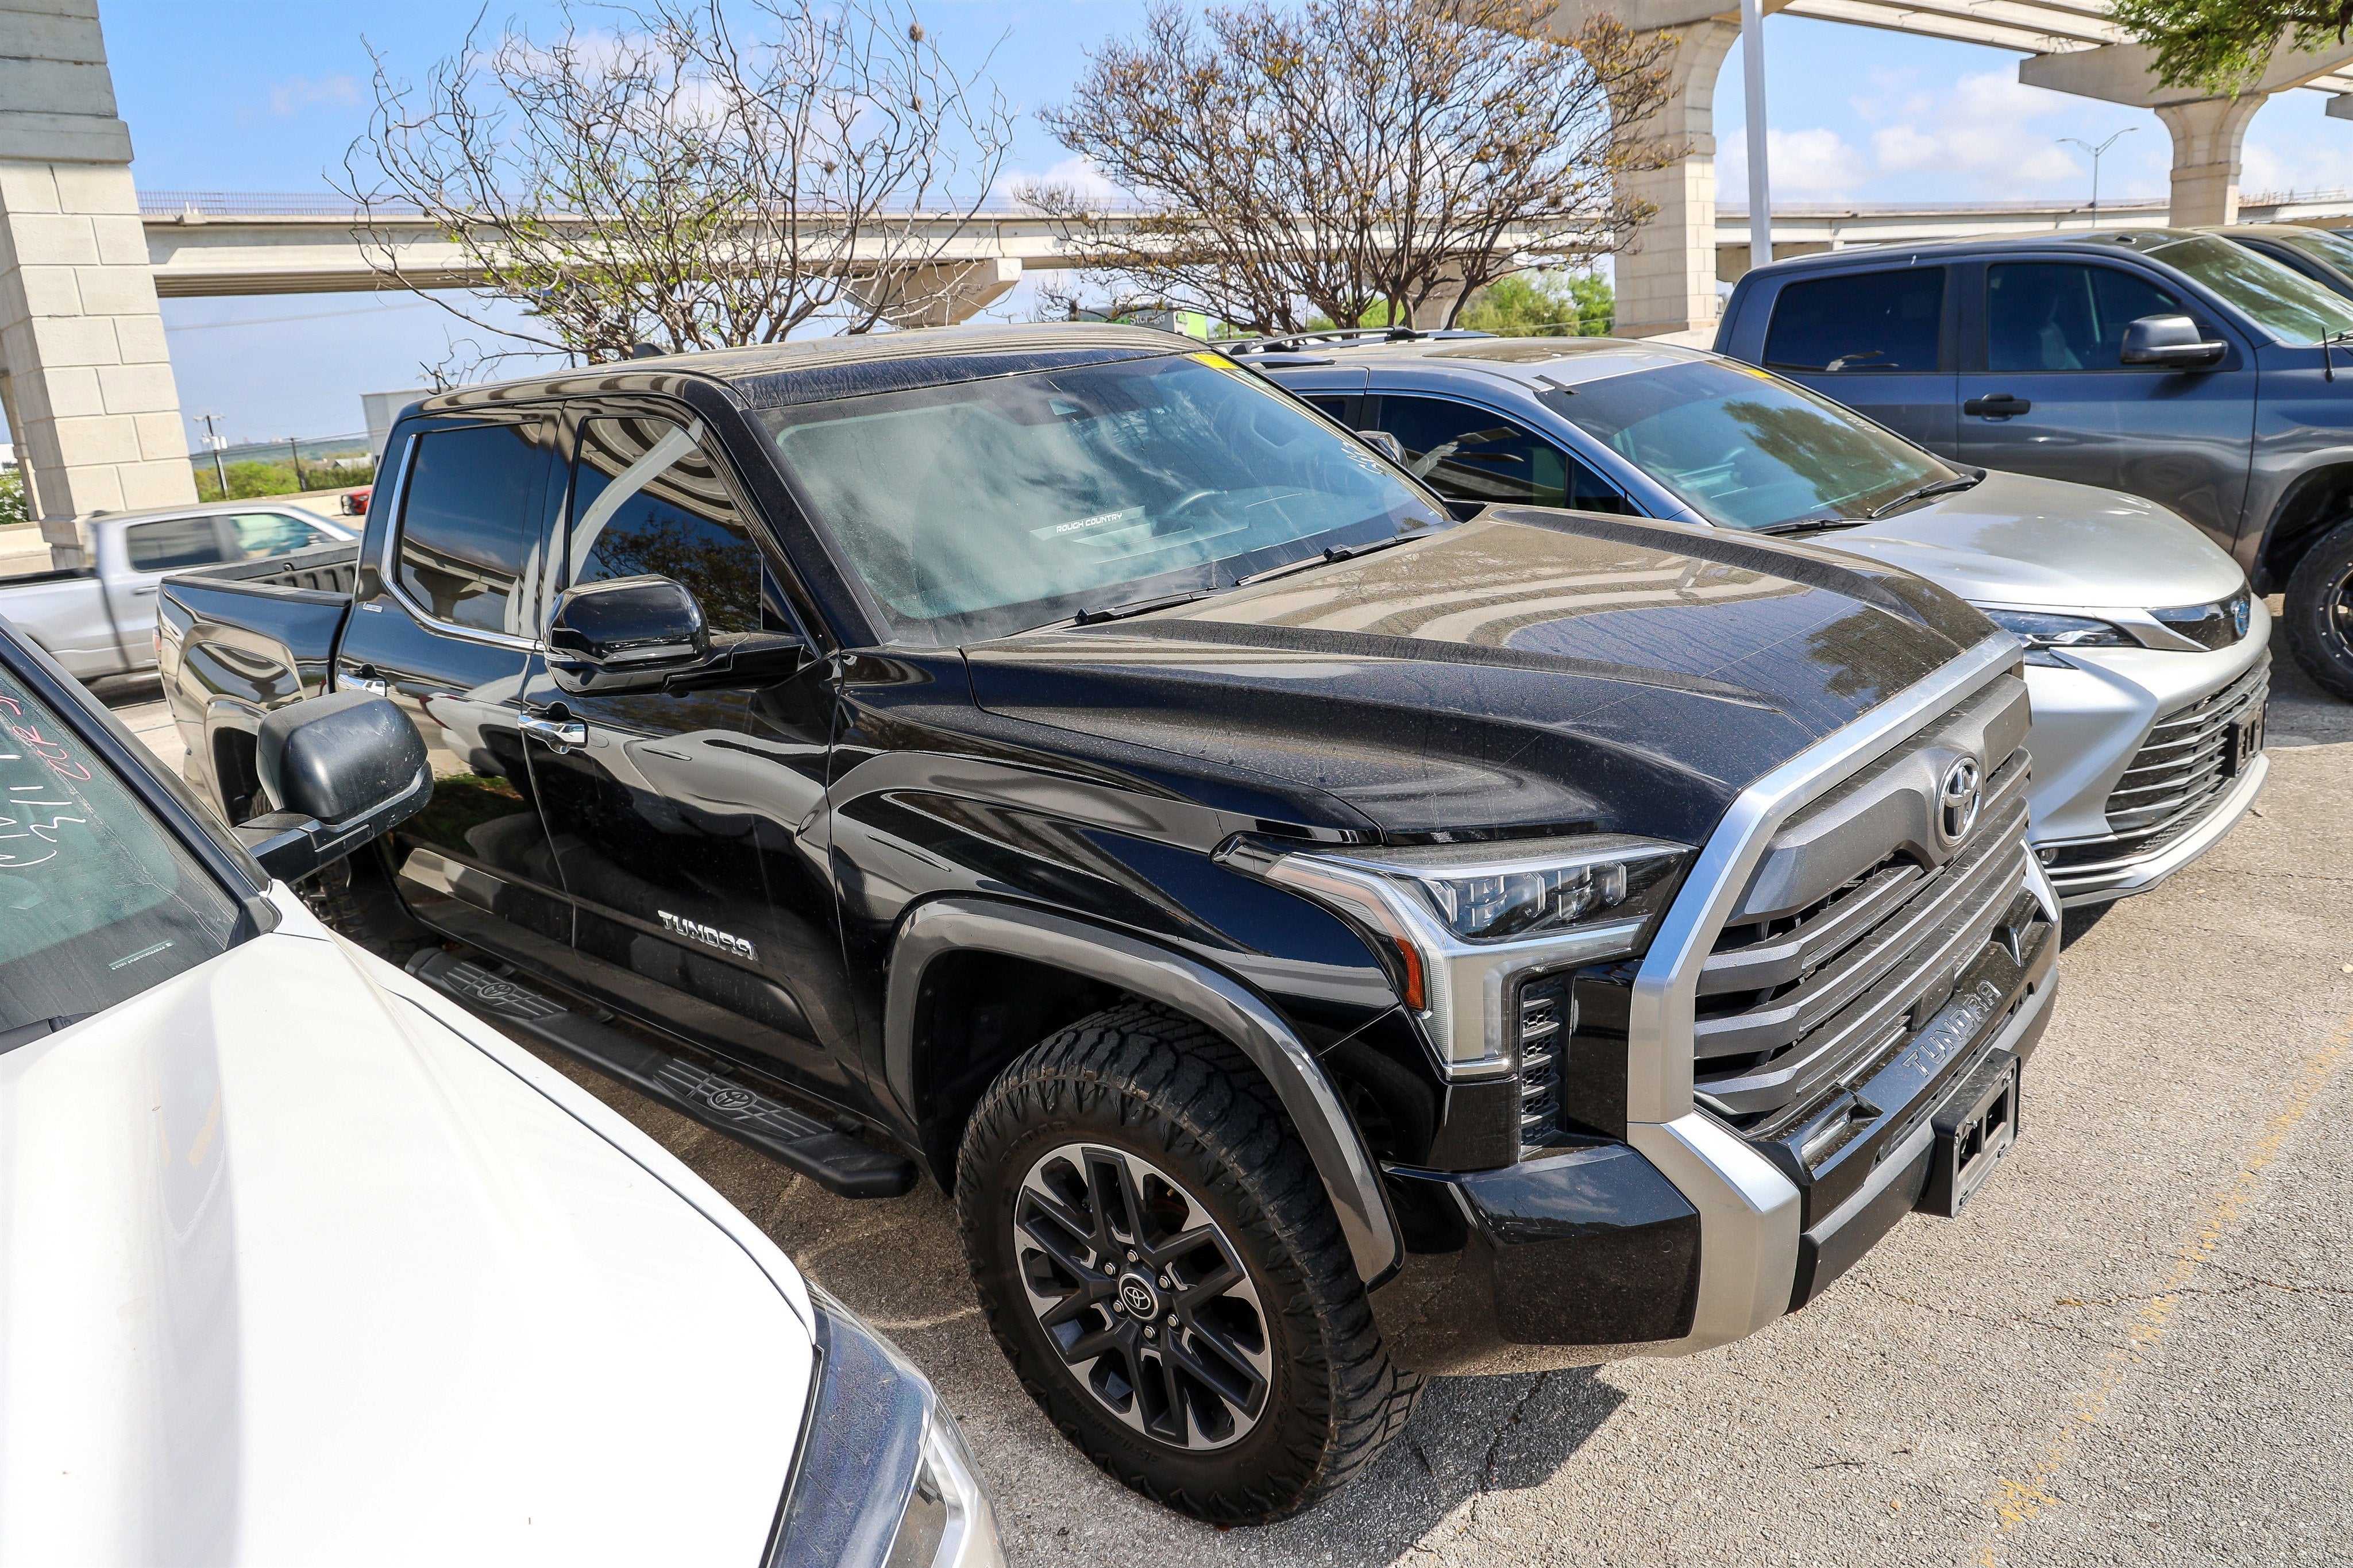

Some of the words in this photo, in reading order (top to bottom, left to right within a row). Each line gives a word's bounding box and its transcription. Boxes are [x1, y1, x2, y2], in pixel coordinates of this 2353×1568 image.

[1056, 520, 1085, 534] ROUGH
[1085, 512, 1123, 527] COUNTRY
[657, 910, 760, 961] TUNDRA
[1901, 980, 2004, 1079] TUNDRA
